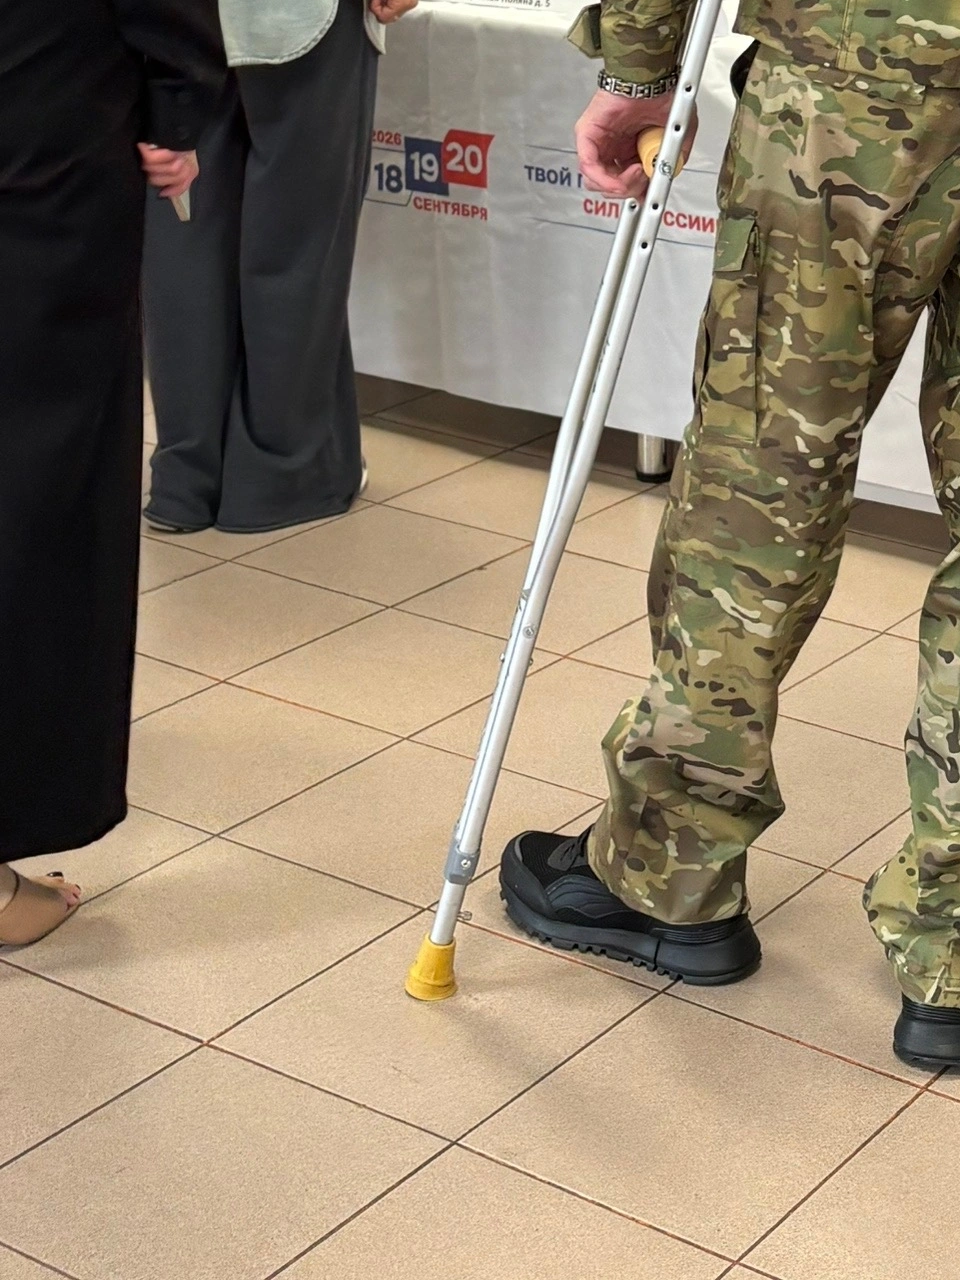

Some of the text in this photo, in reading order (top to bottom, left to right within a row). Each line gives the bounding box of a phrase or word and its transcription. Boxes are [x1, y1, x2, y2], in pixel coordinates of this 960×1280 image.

[545, 0, 551, 7] 5
[374, 141, 483, 193] 18 19 20
[524, 165, 572, 187] ТВОЙ
[413, 196, 488, 221] СЕНТЯБРЯ
[583, 198, 715, 233] СИЛ ССИИ
